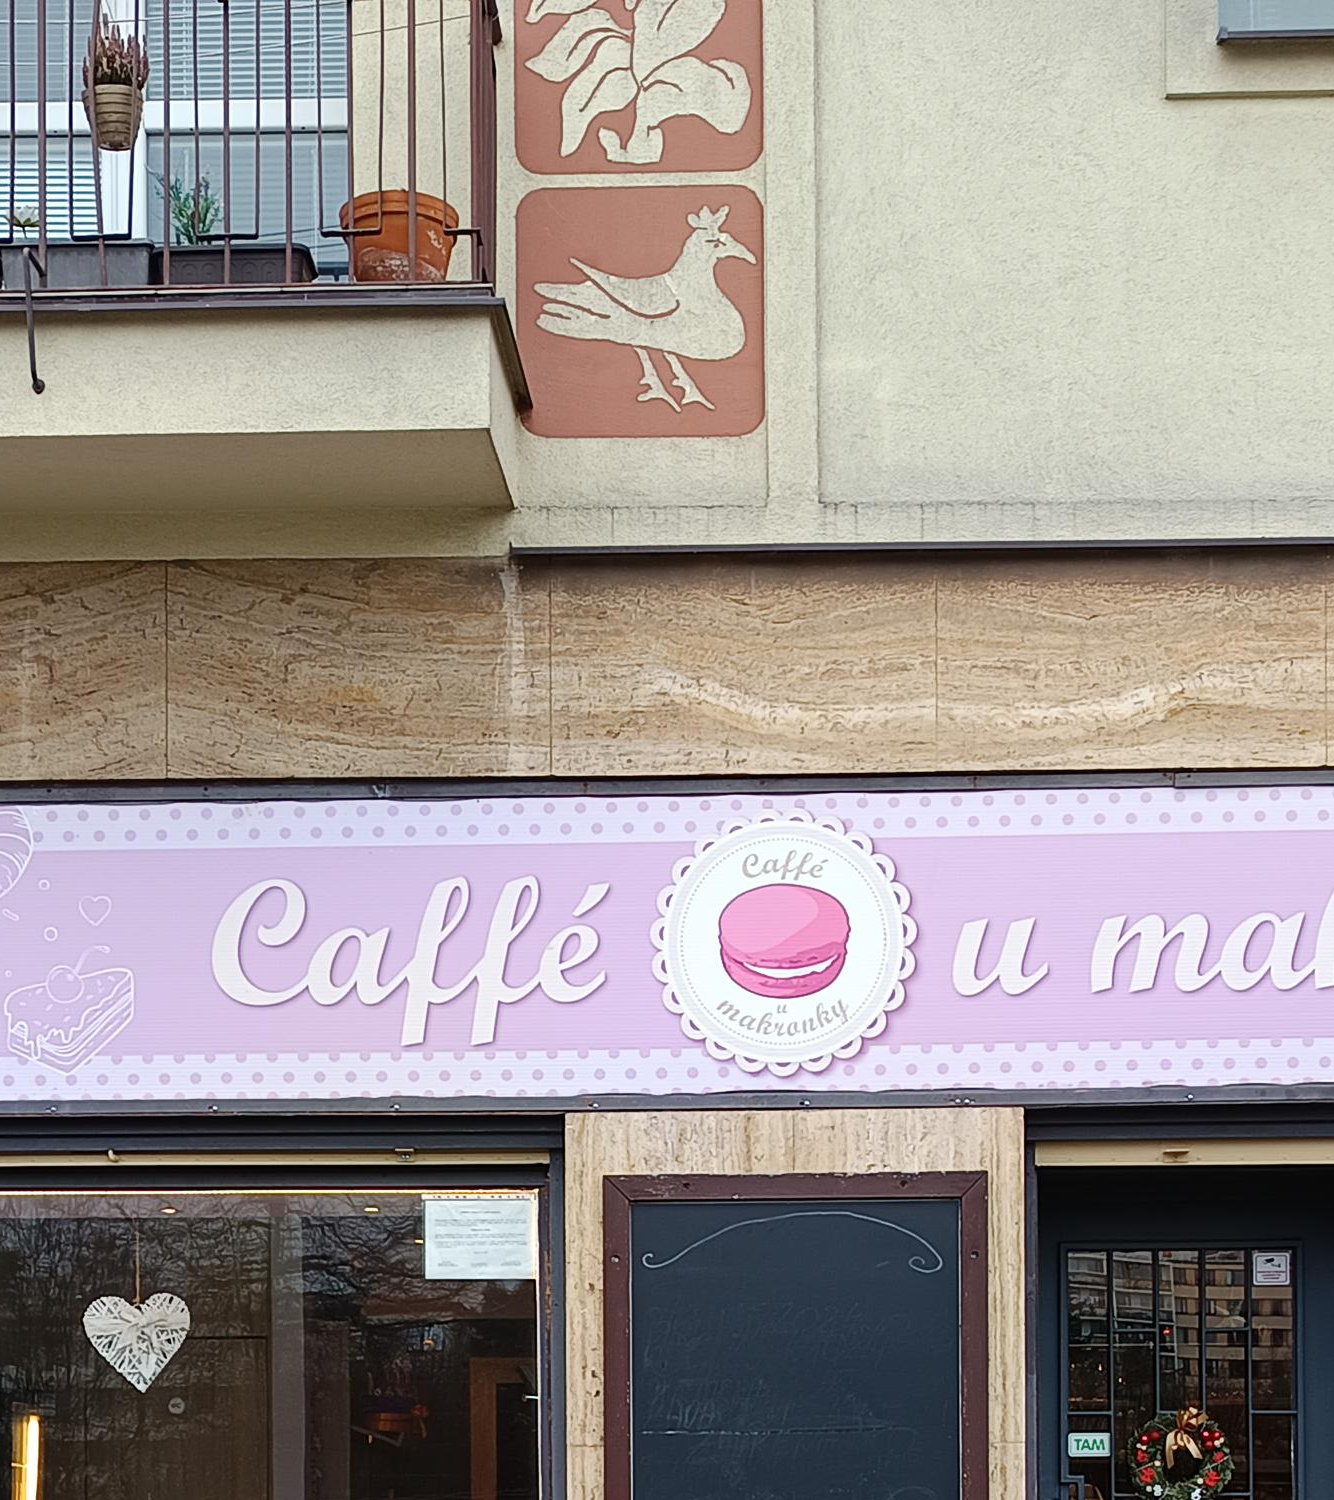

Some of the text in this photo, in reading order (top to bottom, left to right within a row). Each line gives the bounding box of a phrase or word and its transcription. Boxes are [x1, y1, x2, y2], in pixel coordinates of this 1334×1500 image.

[742, 850, 828, 880] Caffé
[211, 875, 610, 1047] Caffé
[952, 916, 1049, 997] u
[717, 998, 849, 1037] makronky
[776, 1004, 788, 1014] u
[1073, 1438, 1105, 1451] TAM
